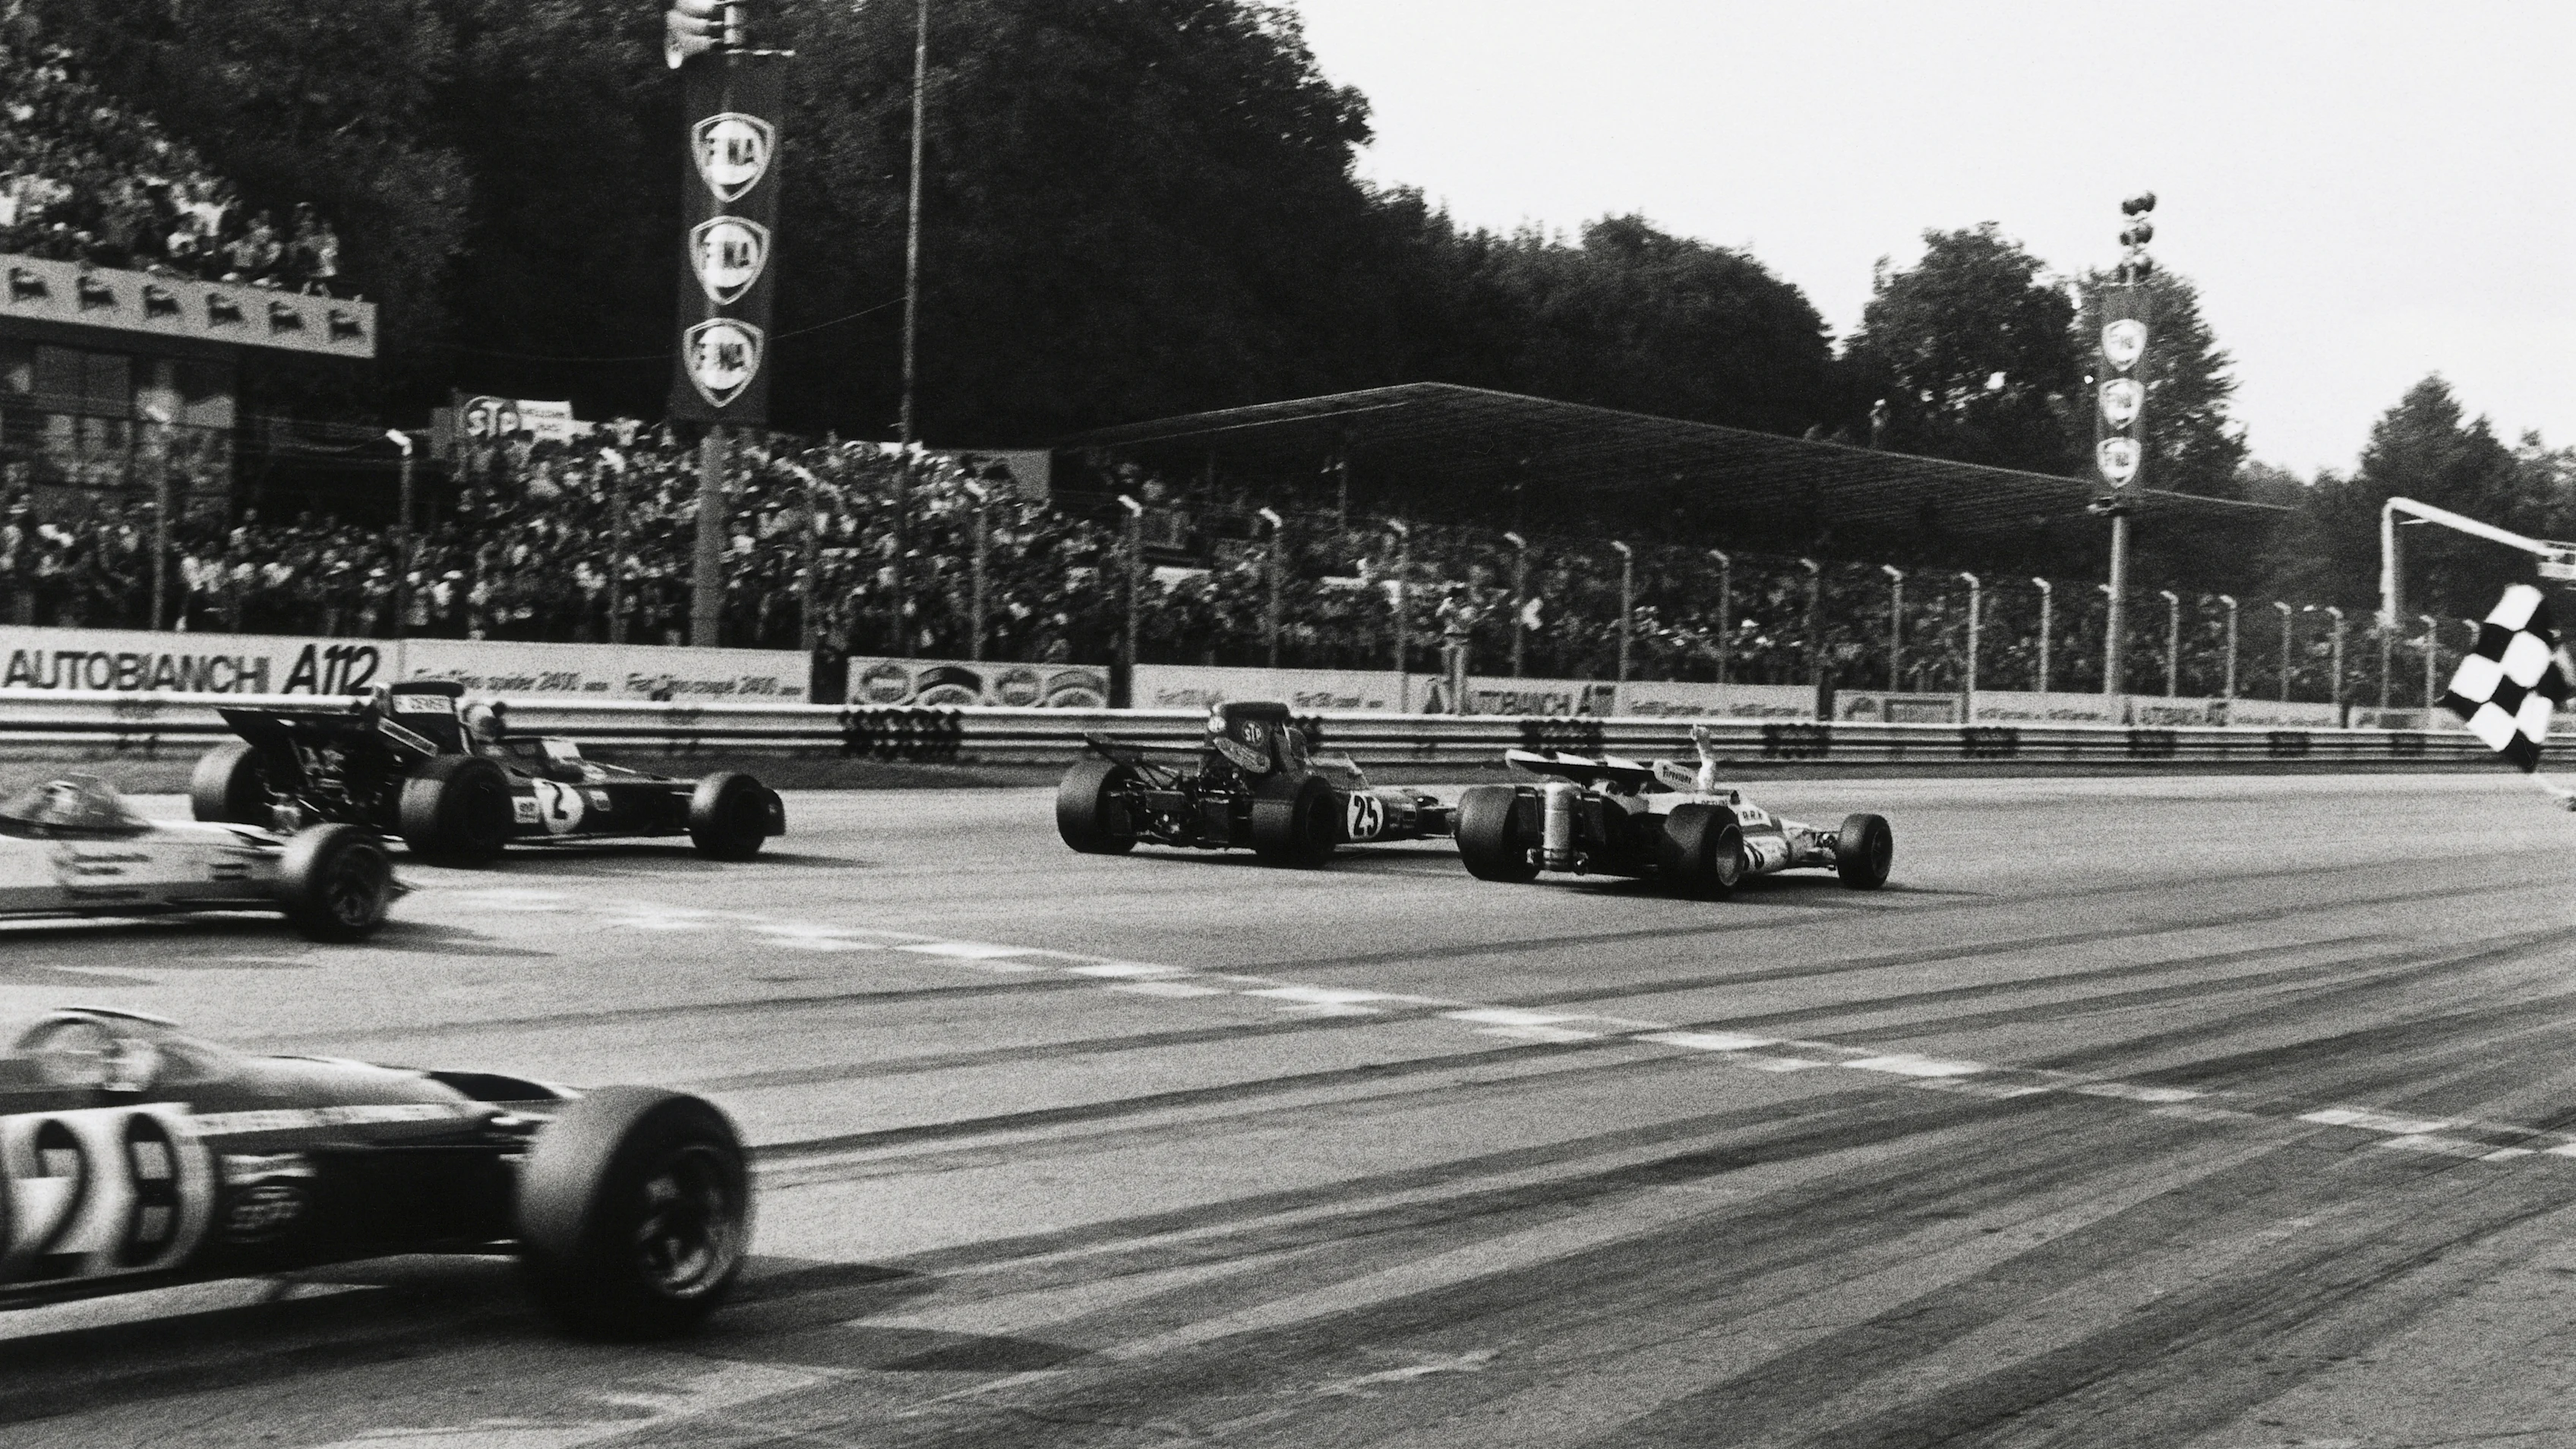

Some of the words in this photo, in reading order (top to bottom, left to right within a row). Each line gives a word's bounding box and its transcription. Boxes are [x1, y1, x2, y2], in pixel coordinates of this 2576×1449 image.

[2, 648, 270, 693] AUTOBIANCHI
[283, 643, 380, 696] A112
[1244, 722, 1262, 743] STP
[541, 781, 569, 819] 2
[1353, 794, 1378, 836] 25
